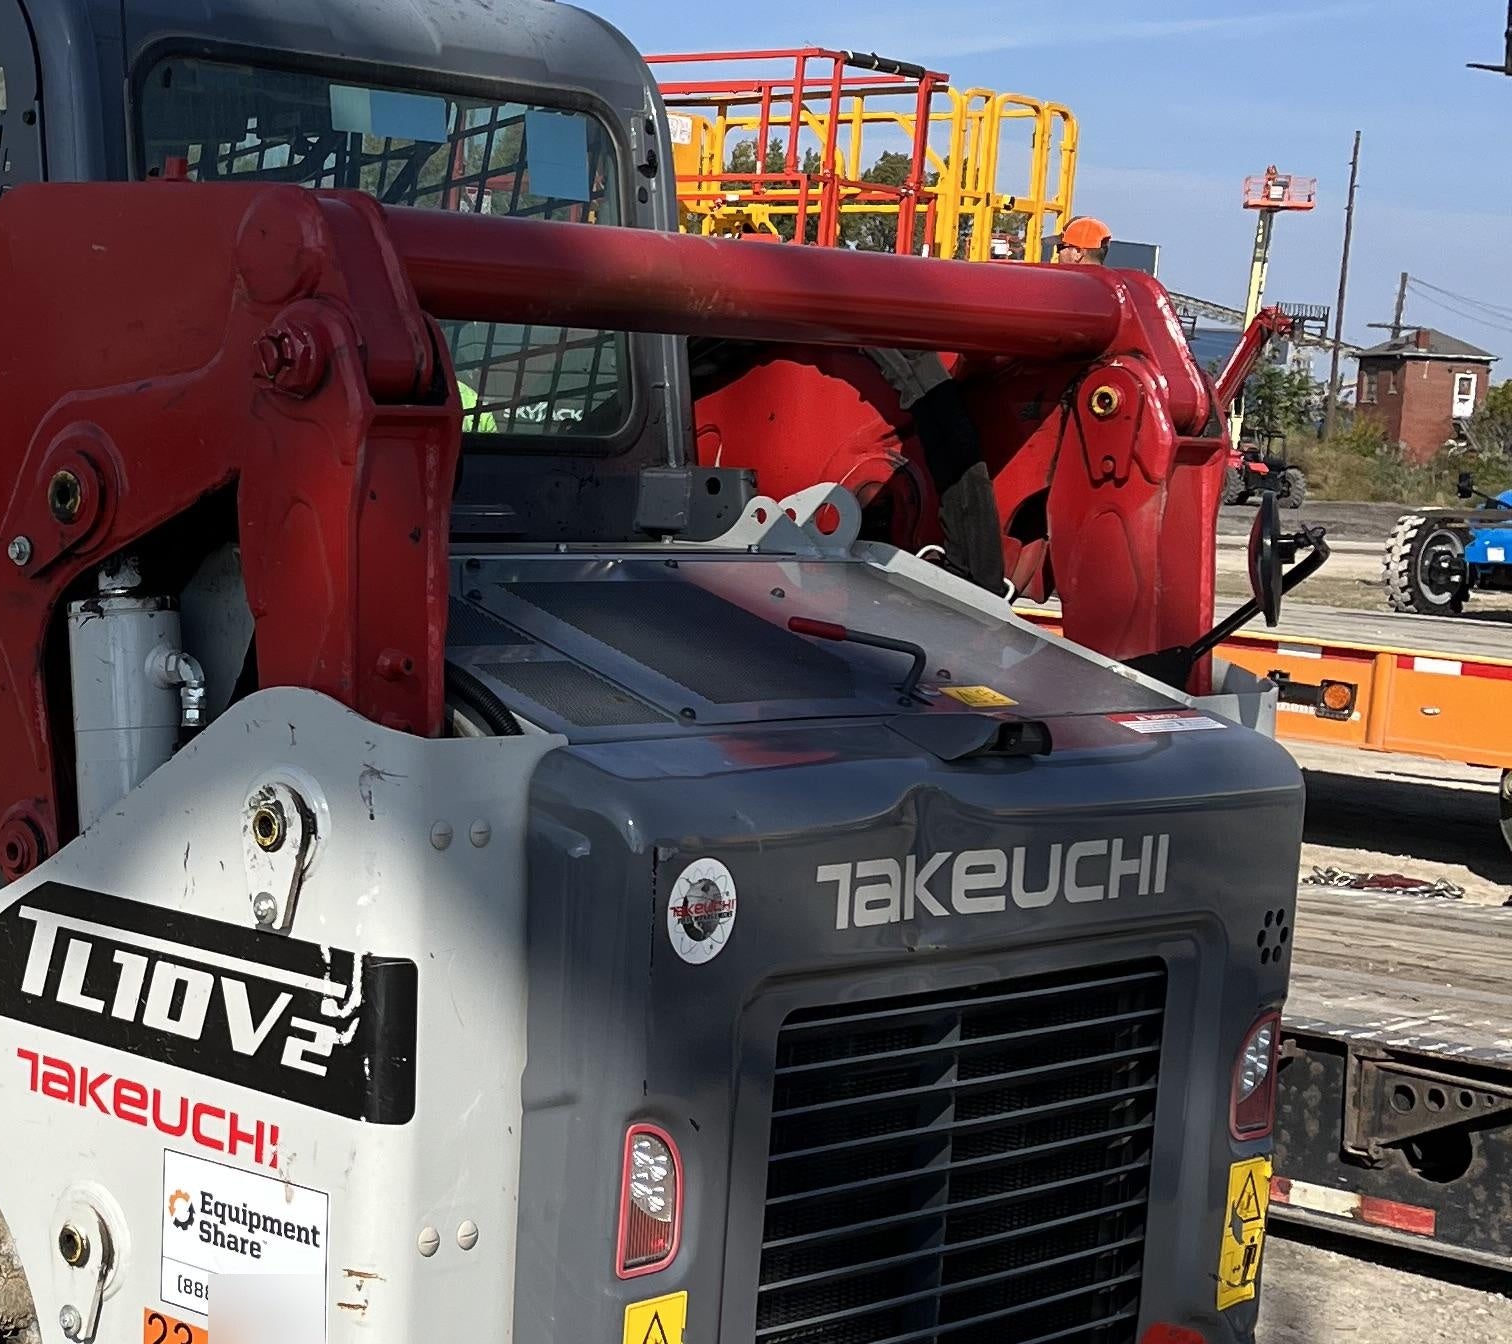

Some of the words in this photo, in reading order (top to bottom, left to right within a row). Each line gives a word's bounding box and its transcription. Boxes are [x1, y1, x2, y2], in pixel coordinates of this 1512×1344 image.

[816, 834, 1170, 930] TAKEUCHI
[18, 905, 347, 1077] TL10V2
[17, 1048, 281, 1169] TAKEUCHI
[198, 1223, 263, 1260] Share
[199, 1190, 321, 1248] Equipment
